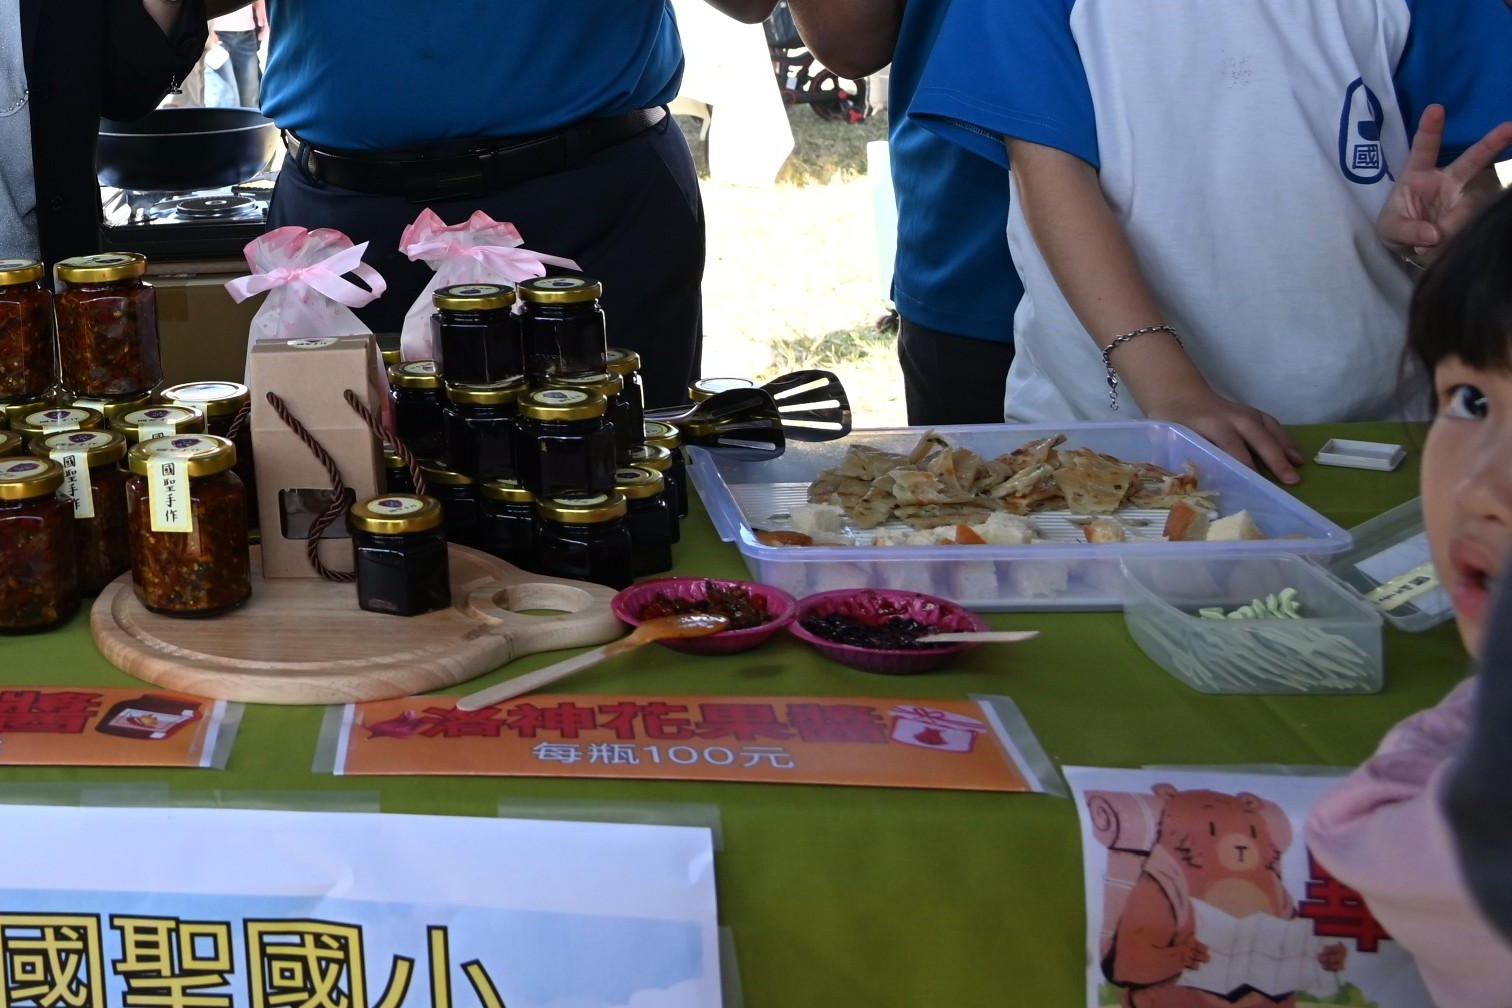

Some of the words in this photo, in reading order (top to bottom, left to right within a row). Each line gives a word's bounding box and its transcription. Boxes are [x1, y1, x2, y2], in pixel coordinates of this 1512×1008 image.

[1351, 144, 1380, 170] 國
[161, 462, 178, 523] 國聖手作
[417, 701, 889, 744] 洛神花果醬
[531, 739, 795, 769] 每瓶100元
